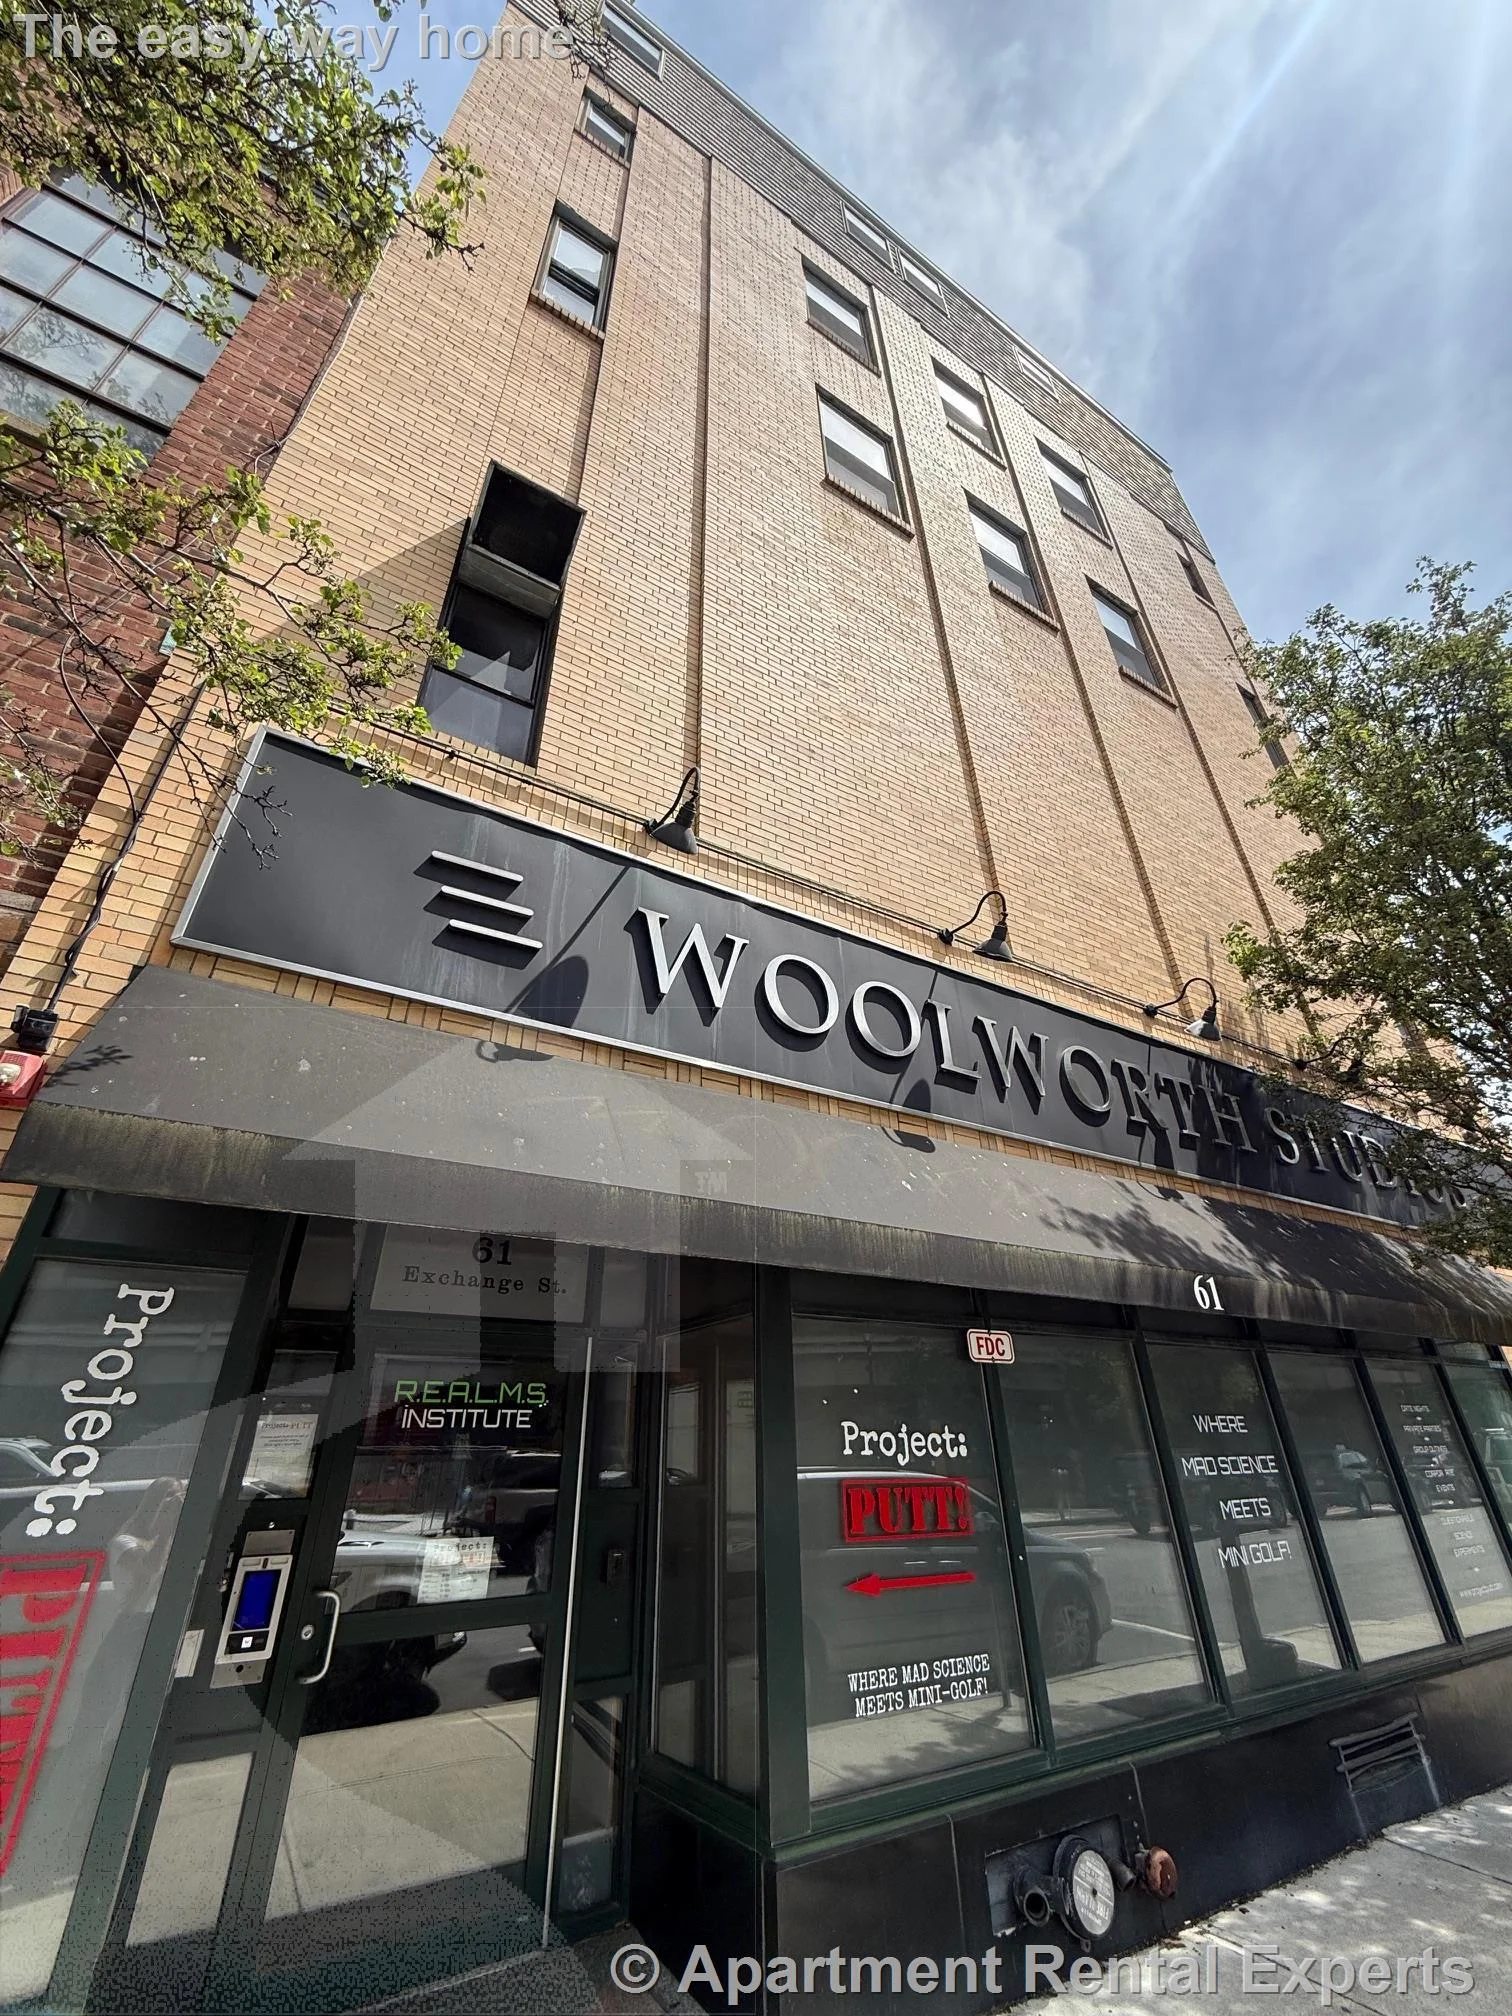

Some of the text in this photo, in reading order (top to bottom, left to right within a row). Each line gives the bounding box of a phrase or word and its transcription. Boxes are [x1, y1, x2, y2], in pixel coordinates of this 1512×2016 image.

[638, 907, 1257, 1152] WOOLWORTH
[472, 1237, 512, 1265] 61
[402, 1265, 566, 1294] Exchange St.
[1194, 1275, 1224, 1310] 61
[976, 1336, 1006, 1356] FDC
[26, 1284, 175, 1537] Project:
[1193, 1415, 1248, 1433] WHERE
[841, 1421, 967, 1466] Project:
[1181, 1455, 1279, 1476] MAD SCIENCE
[848, 1486, 967, 1534] PUTT!
[1220, 1498, 1271, 1520] MEETS
[1218, 1540, 1292, 1568] MINI GOLF!
[848, 1654, 990, 1692] WHERE MAD SCIENCE
[855, 1677, 988, 1717] MEETS MINI-GOLF!
